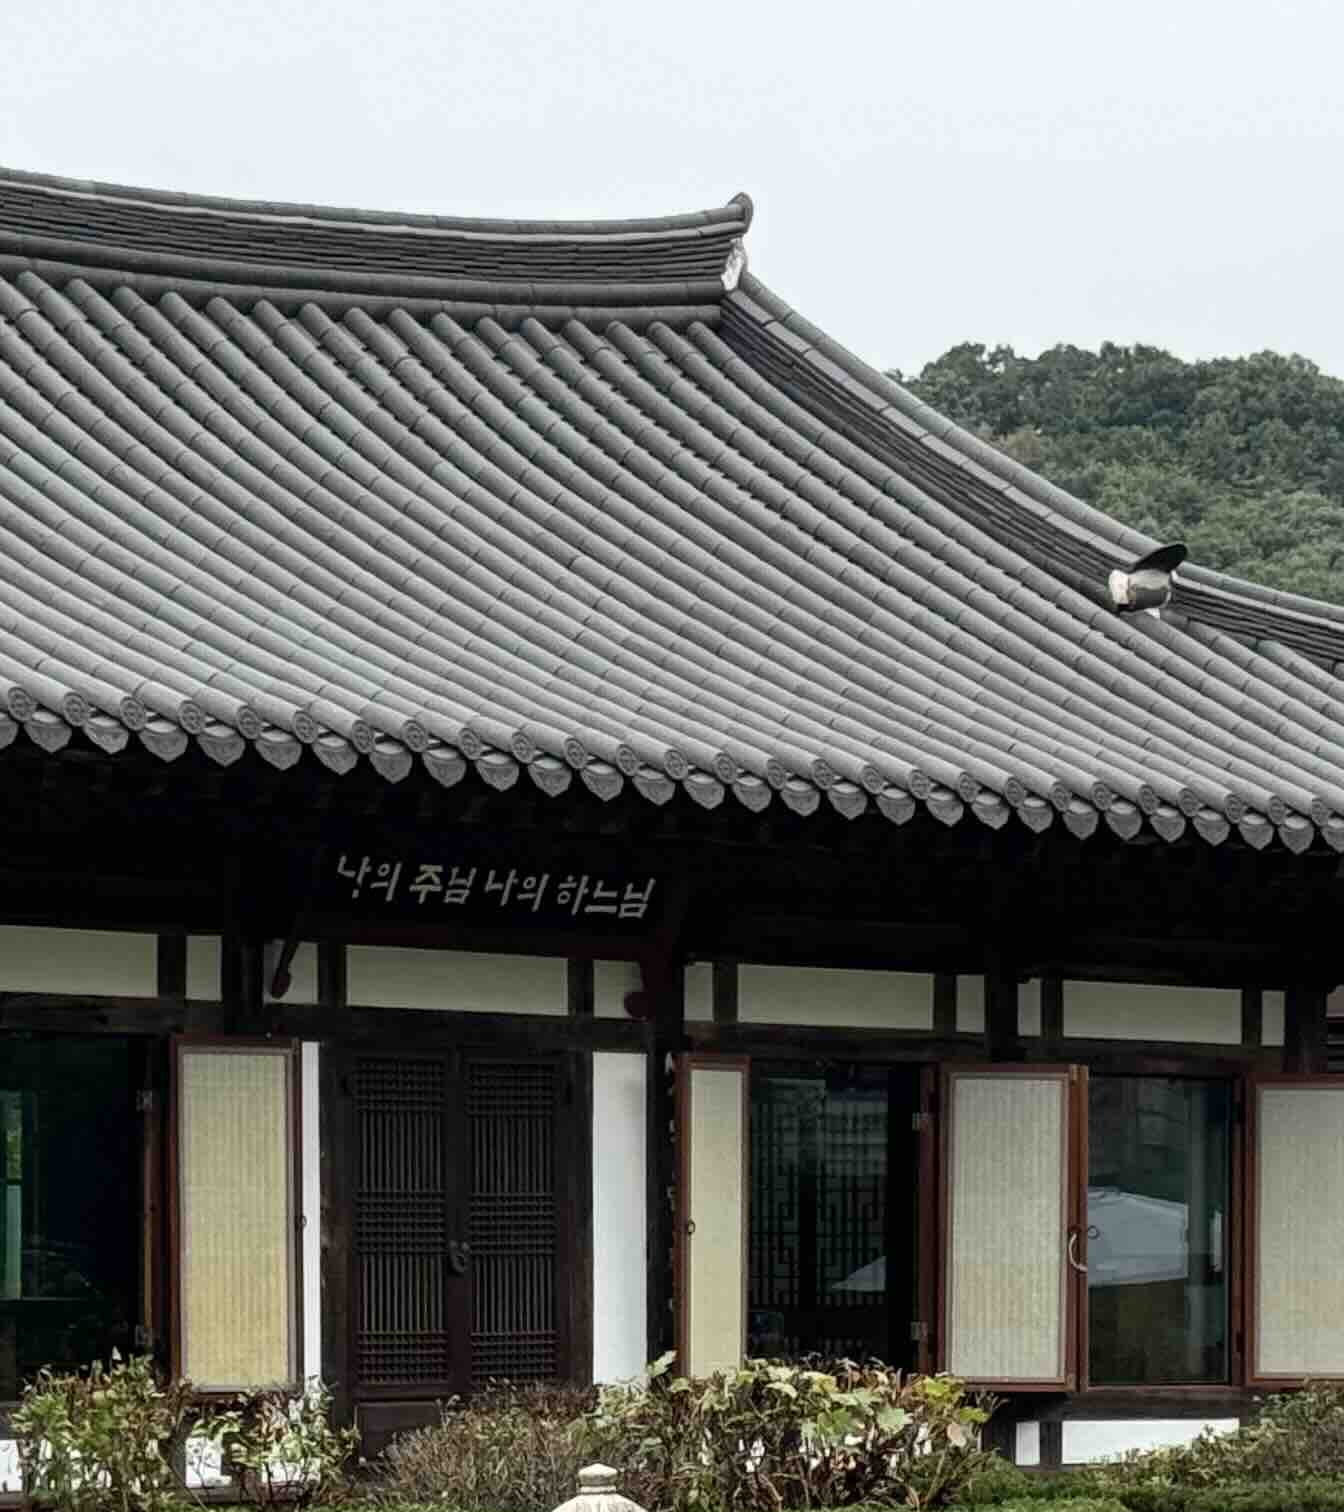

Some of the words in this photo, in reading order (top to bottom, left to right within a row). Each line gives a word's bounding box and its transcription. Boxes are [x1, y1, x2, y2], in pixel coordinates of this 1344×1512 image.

[336, 855, 403, 902] 나의
[409, 863, 477, 905] 주님
[484, 868, 550, 912] 나의
[556, 874, 657, 918] 하느님
